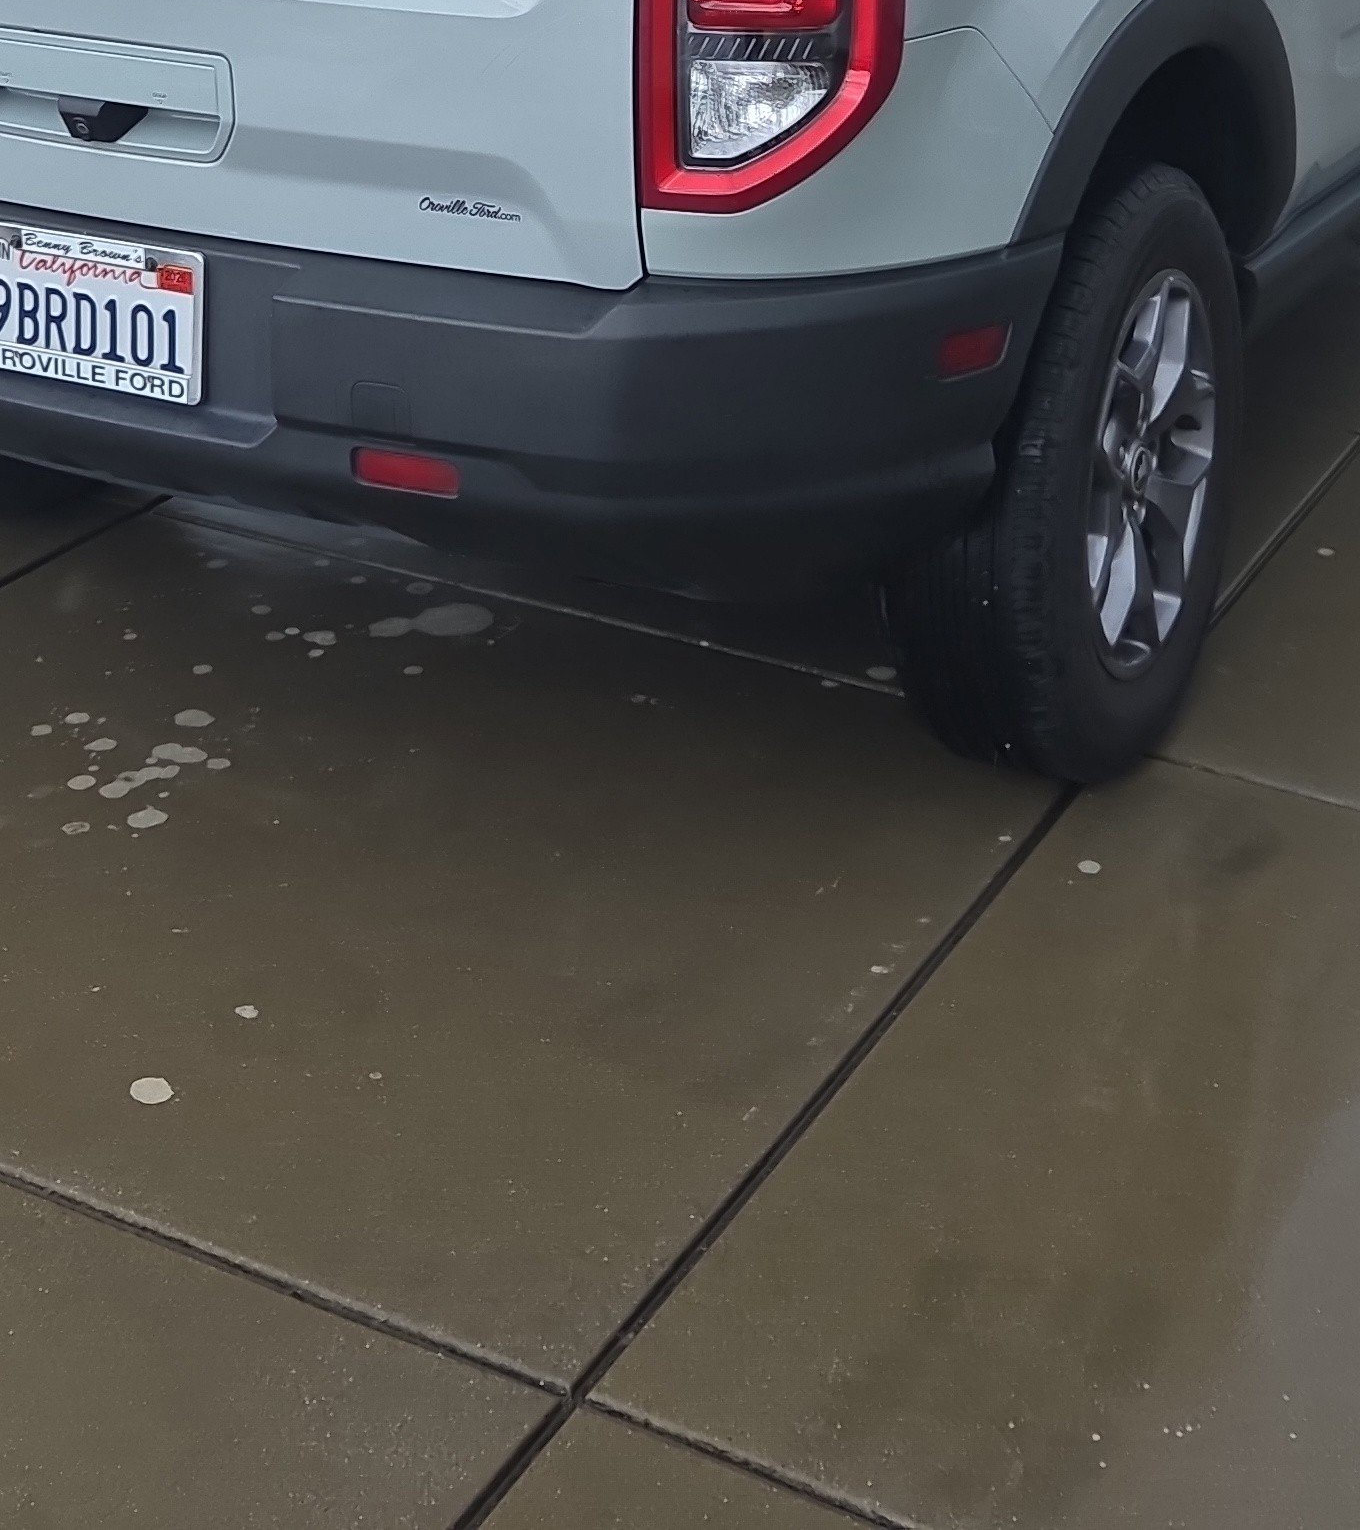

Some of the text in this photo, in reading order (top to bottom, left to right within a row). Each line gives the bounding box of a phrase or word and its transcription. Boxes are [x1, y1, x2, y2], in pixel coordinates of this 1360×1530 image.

[23, 232, 144, 264] Benny Brown's
[115, 368, 185, 400] FORD
